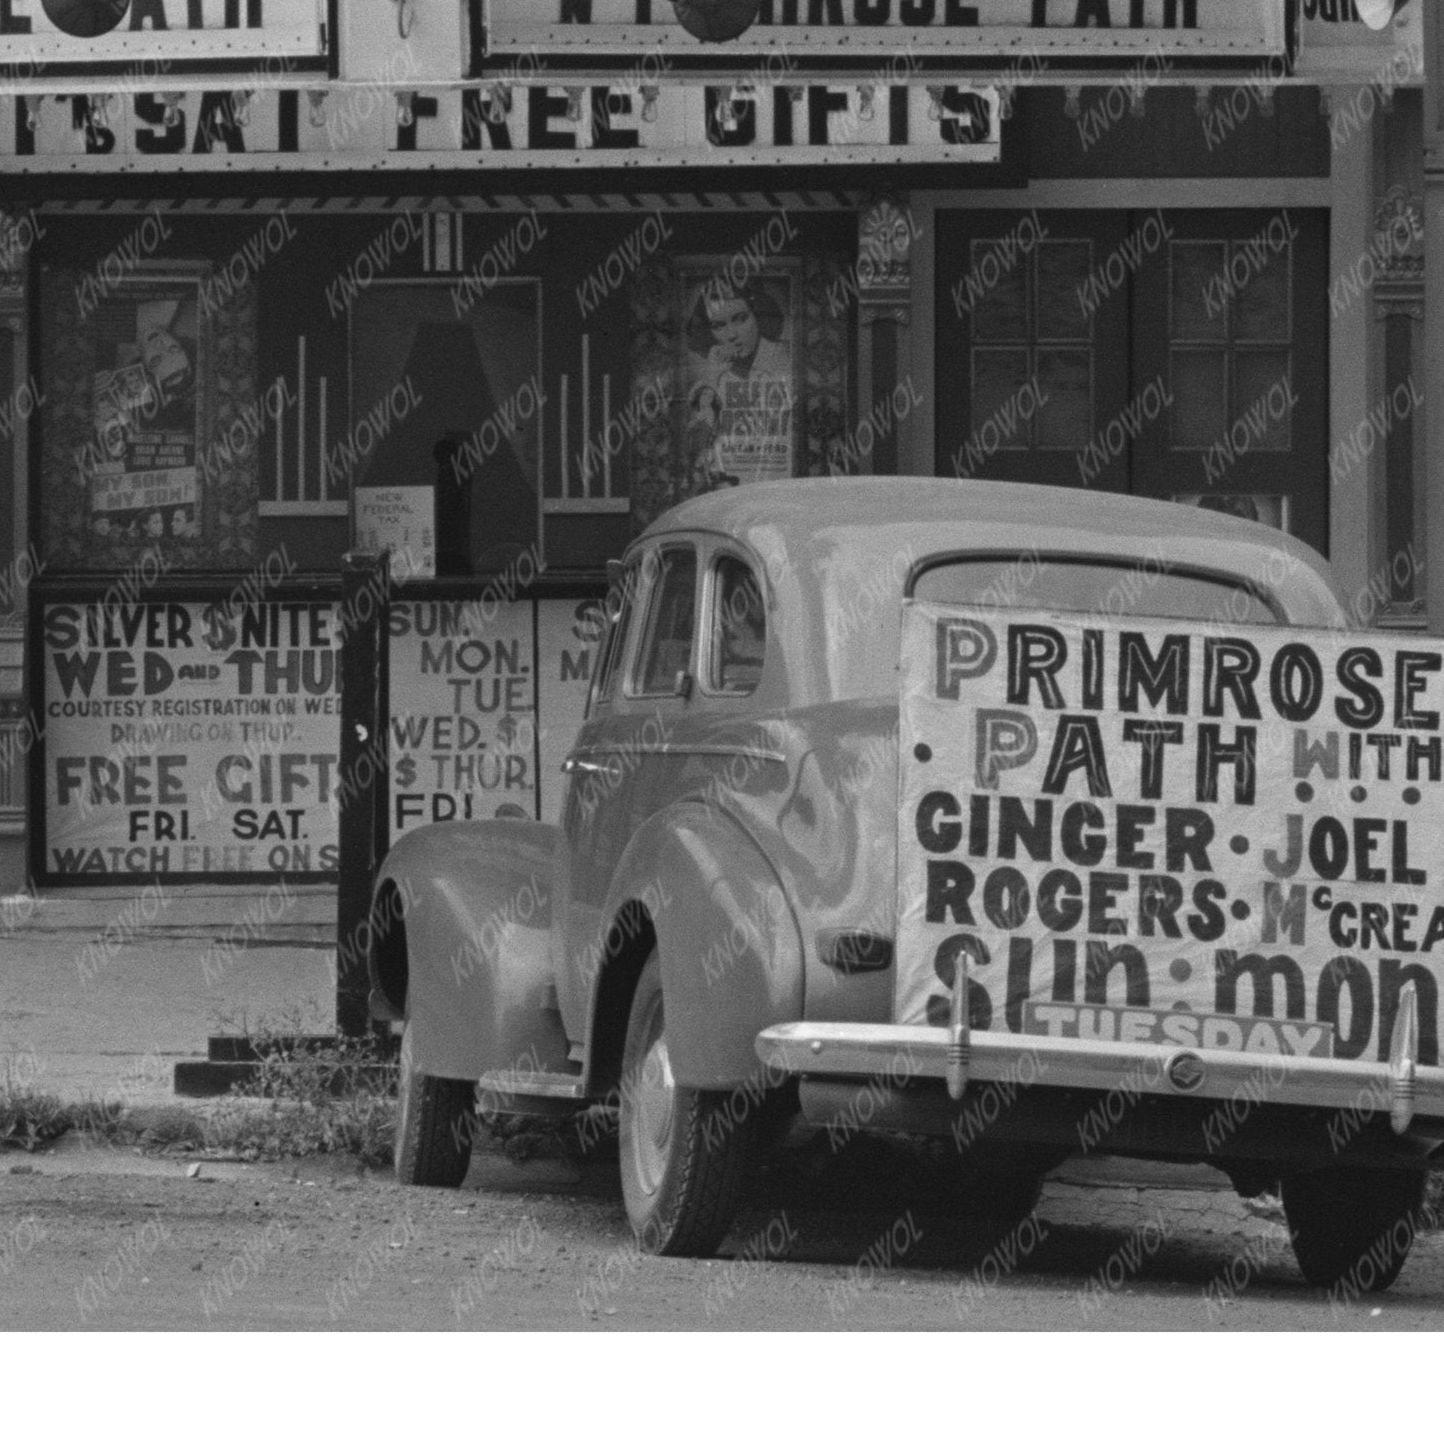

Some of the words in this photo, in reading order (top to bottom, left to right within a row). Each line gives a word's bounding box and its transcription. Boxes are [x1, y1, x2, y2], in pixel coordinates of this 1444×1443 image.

[396, 84, 640, 149] FREE
[45, 604, 194, 649] SILVER
[241, 603, 343, 648] NITE
[53, 651, 175, 699] WED
[177, 664, 221, 682] AND
[223, 650, 344, 695] THU
[421, 639, 530, 675] MON.
[935, 617, 1442, 731] PRIMROSE
[48, 699, 146, 719] COURTESY
[152, 698, 271, 716] REGISTRATION
[275, 699, 297, 716] ON
[391, 716, 488, 750] WED.
[111, 722, 203, 745] DRAWING
[974, 708, 1256, 805] PATH
[1293, 730, 1442, 781] WITH
[57, 755, 188, 806] FREE
[214, 753, 339, 804] GIFT
[129, 809, 196, 842] FRI.
[232, 808, 309, 841] SAT.
[916, 791, 1214, 871] GINGER
[1263, 814, 1427, 885] JOEL
[54, 847, 170, 871] WATCH
[267, 844, 311, 871] ON
[926, 860, 1226, 942] ROGERS
[1035, 1004, 1323, 1058] TUESDAY
